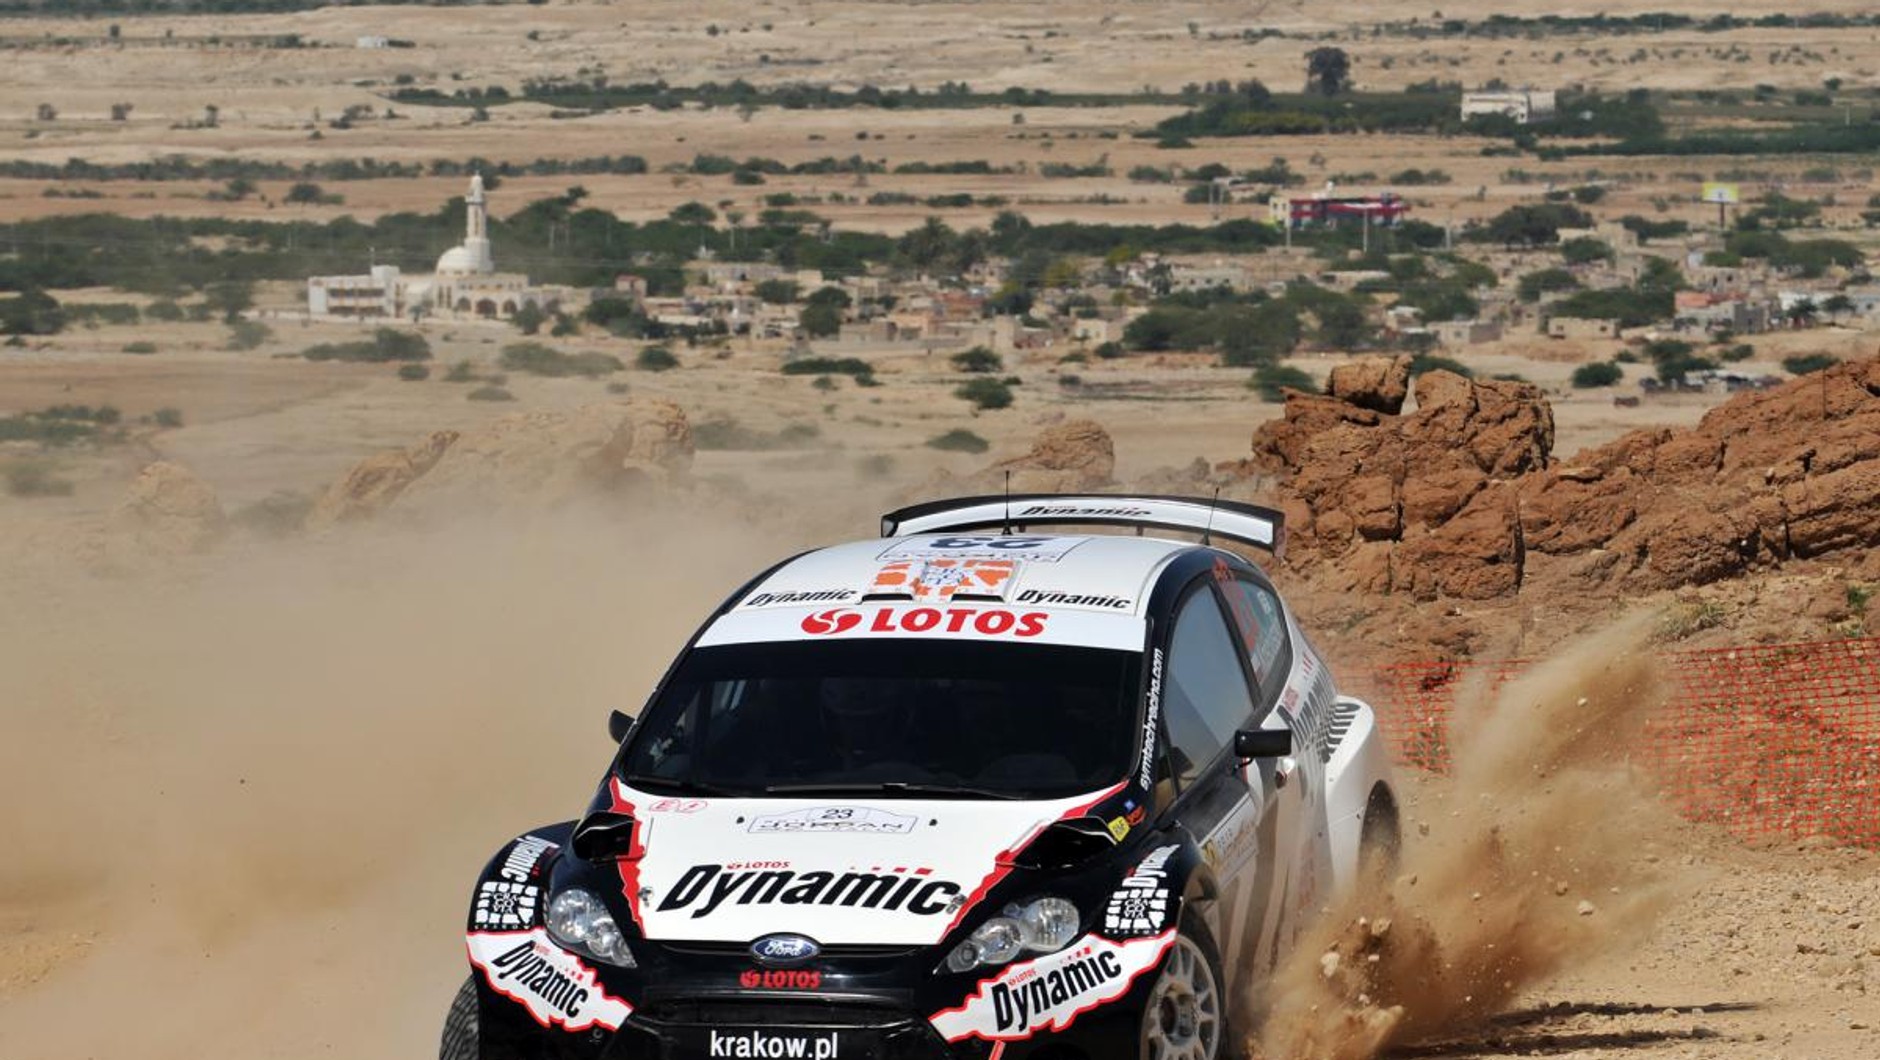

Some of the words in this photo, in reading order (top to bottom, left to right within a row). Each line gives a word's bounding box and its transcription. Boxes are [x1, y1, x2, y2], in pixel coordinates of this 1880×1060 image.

[746, 589, 857, 606] Dynamic
[1015, 589, 1130, 609] Dynamic
[870, 608, 1049, 637] LOTOS
[821, 808, 854, 820] 23
[745, 861, 790, 869] LOTOS
[656, 864, 958, 919] Dynamic
[764, 938, 804, 956] Ford
[492, 940, 588, 1018] Dynamic
[763, 970, 822, 989] LOTOS
[991, 950, 1122, 1032] Dynamic
[710, 1030, 838, 1060] krakow.pl
